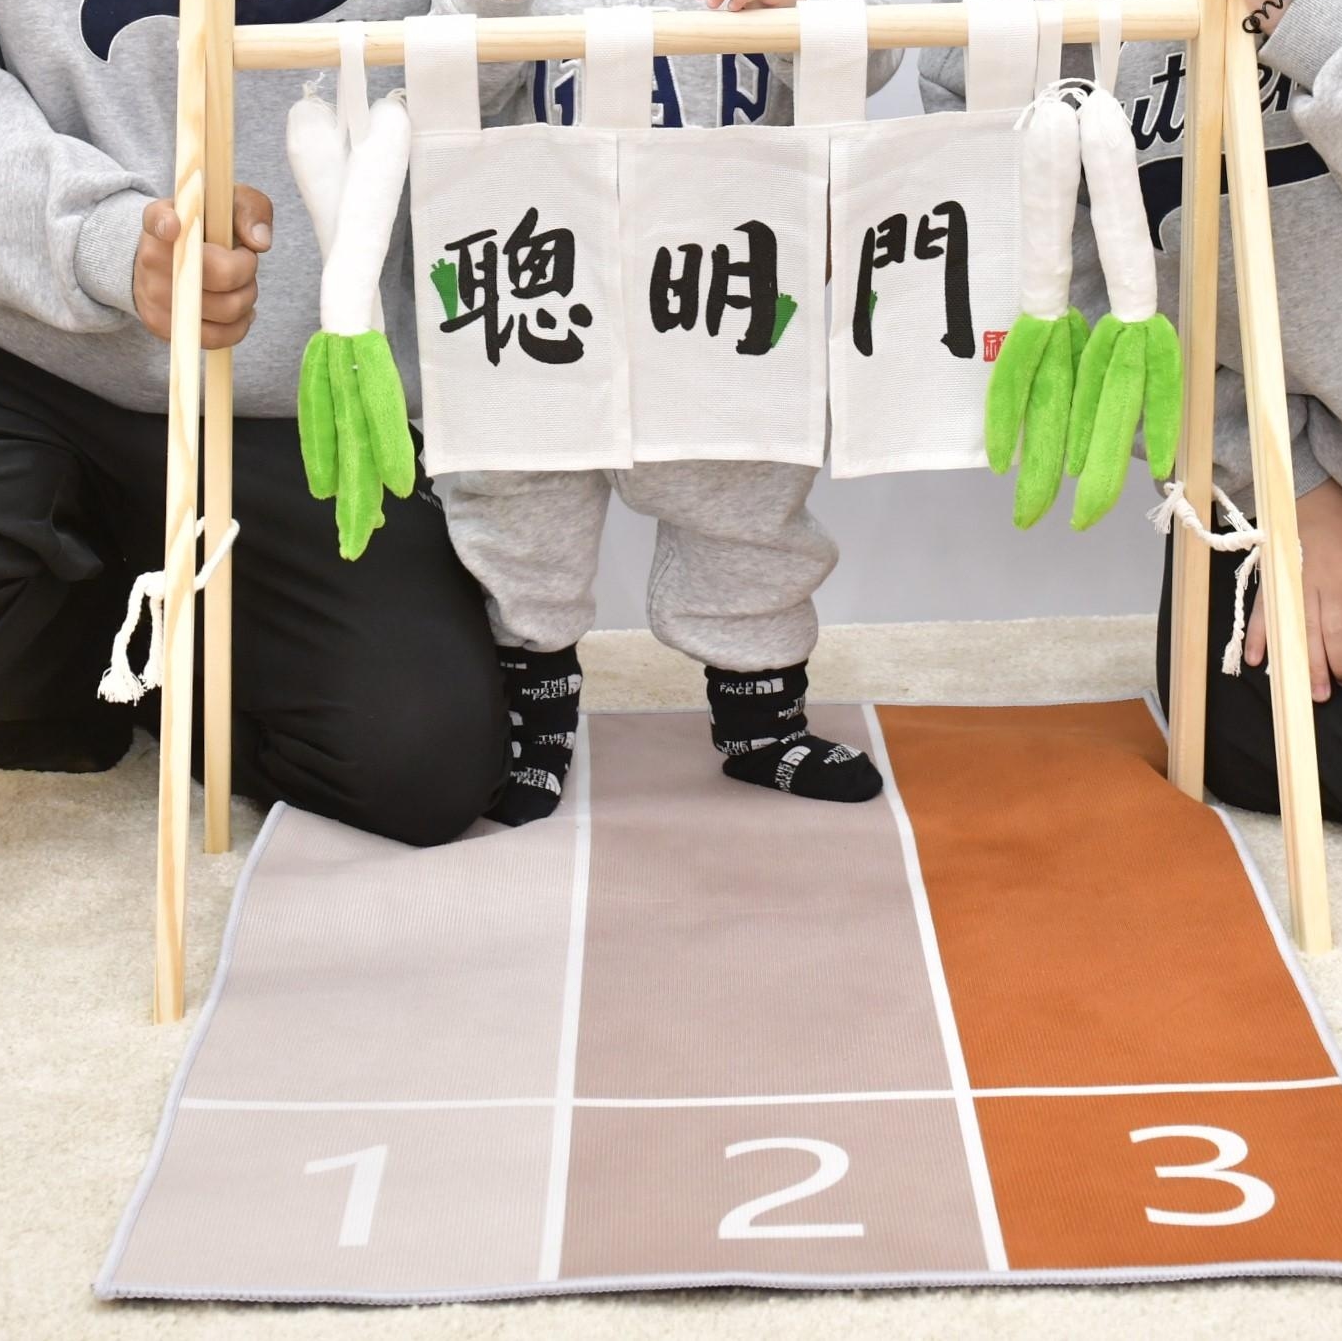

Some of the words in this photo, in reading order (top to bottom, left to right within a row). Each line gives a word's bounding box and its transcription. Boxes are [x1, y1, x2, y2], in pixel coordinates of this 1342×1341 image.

[440, 199, 976, 367] 聰明門
[540, 677, 567, 689] THE
[719, 683, 754, 695] FACE
[302, 1143, 391, 1247] 1
[717, 1135, 865, 1241] 2
[1129, 1124, 1278, 1226] 3
